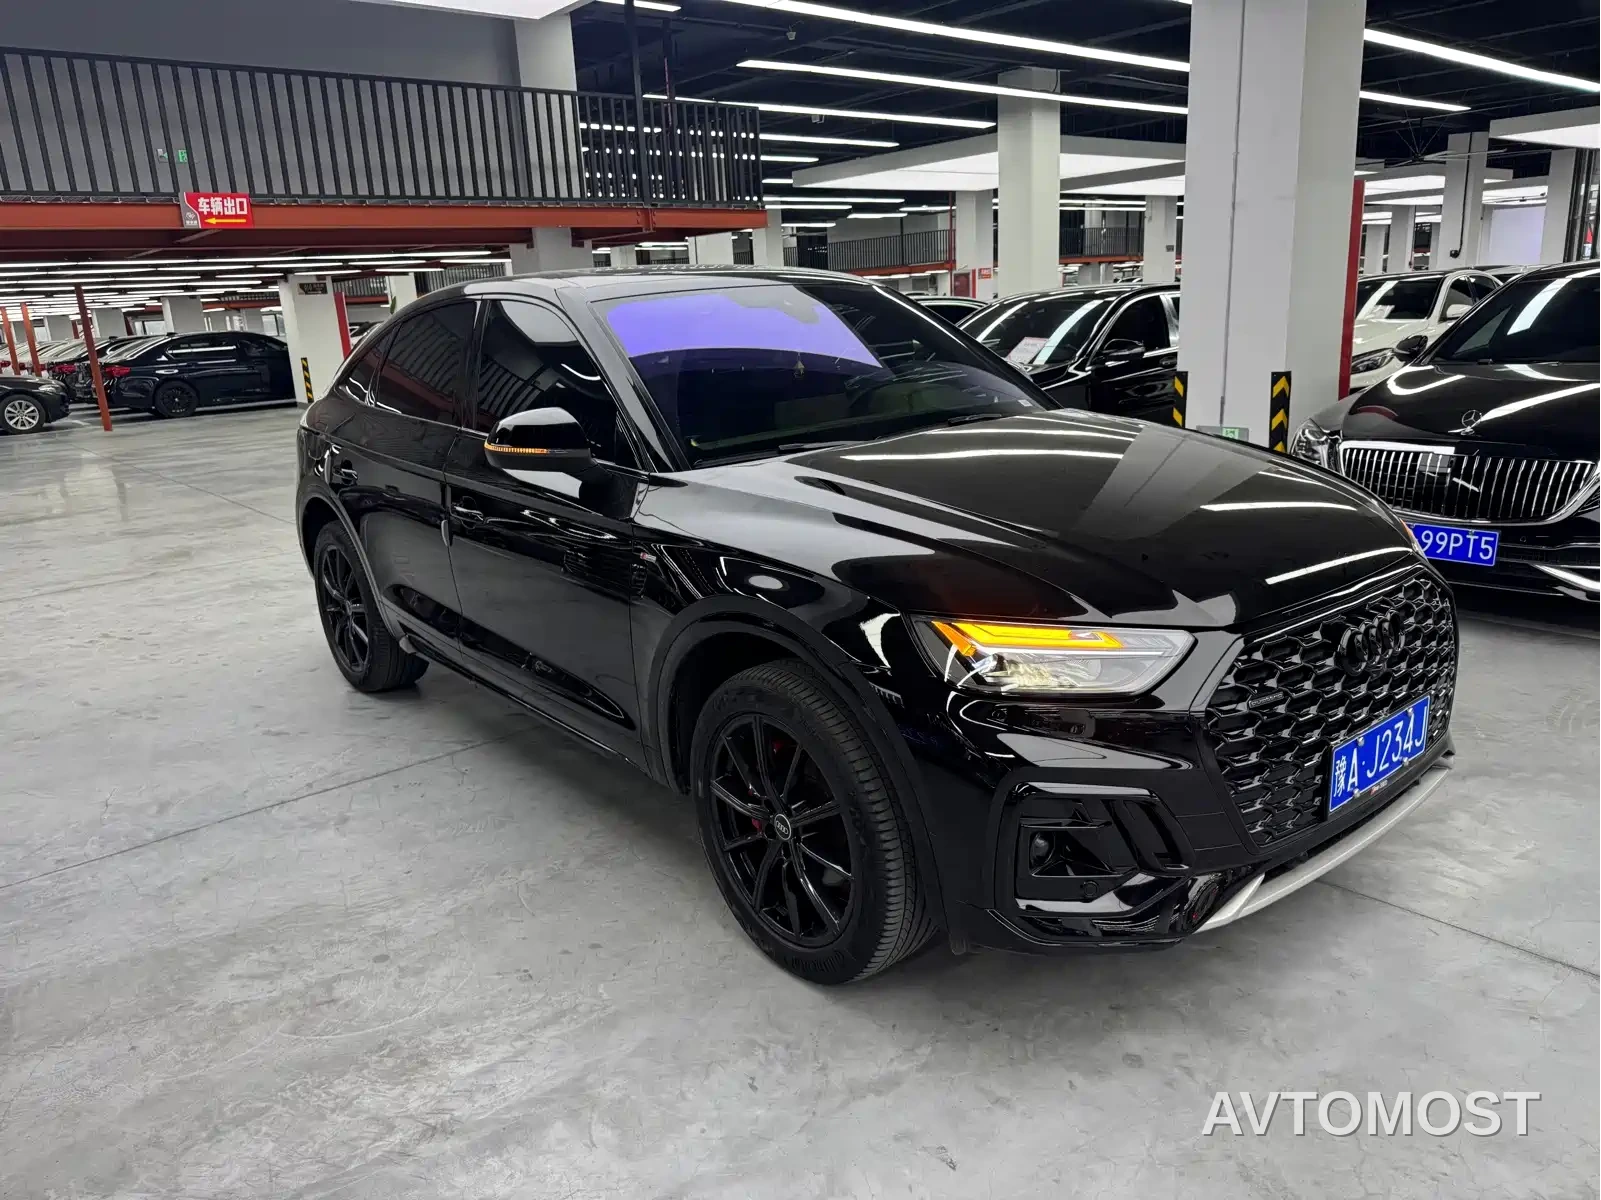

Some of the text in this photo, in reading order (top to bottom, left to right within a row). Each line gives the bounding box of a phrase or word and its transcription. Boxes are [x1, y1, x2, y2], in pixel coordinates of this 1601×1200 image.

[198, 197, 248, 215] 车辆出口
[1421, 530, 1494, 560] 99PT5
